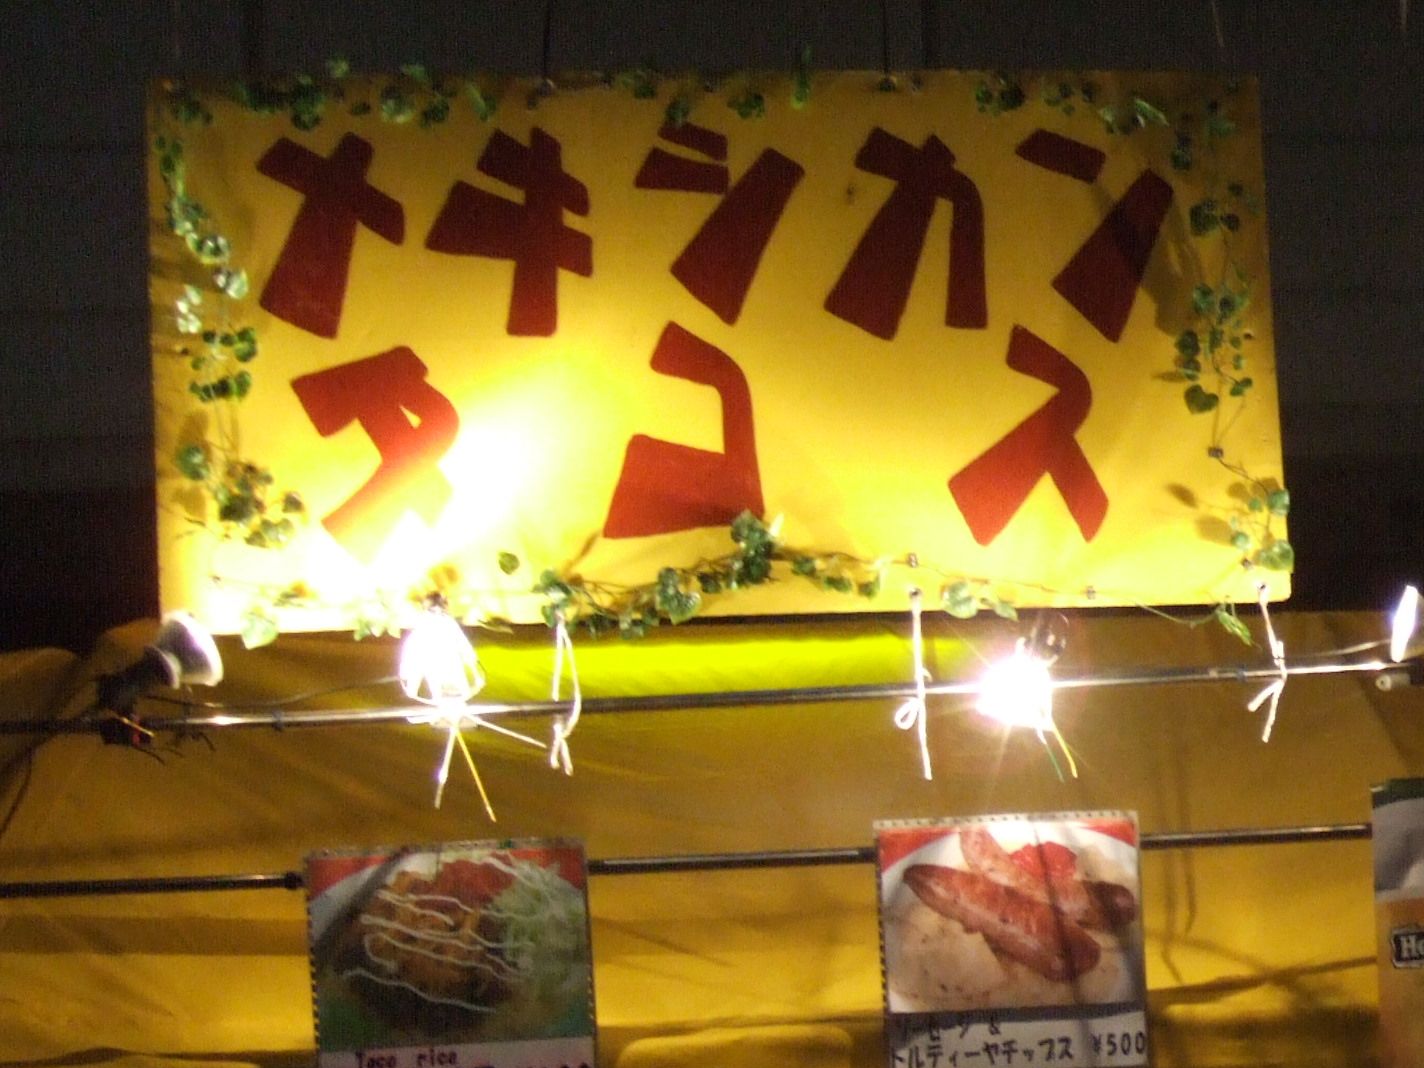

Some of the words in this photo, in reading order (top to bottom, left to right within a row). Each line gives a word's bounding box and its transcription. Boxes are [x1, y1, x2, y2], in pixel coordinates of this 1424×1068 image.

[256, 124, 1174, 344] メキシカン
[290, 318, 1110, 566] タコス
[417, 1049, 459, 1066] rice
[1091, 1029, 1145, 1057] ¥500
